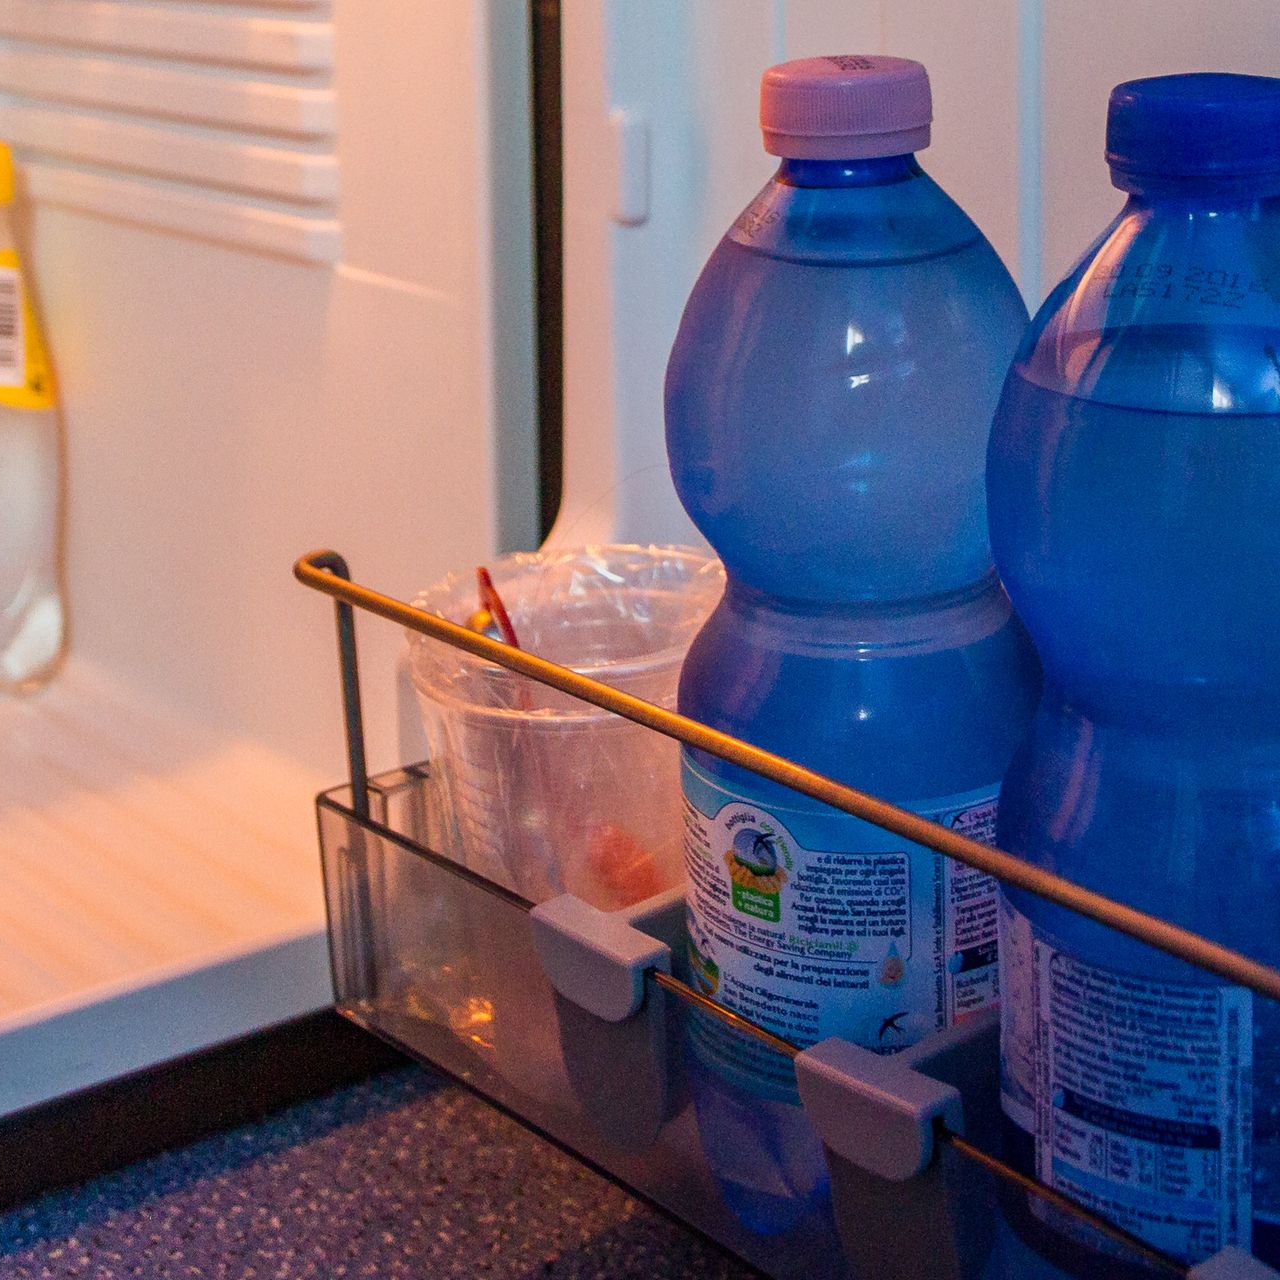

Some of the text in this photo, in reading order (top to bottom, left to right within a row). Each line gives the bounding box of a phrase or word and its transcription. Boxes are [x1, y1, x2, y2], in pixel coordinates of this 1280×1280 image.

[873, 854, 906, 869] plastica
[844, 867, 858, 877] per
[836, 886, 873, 896] emissioni
[866, 907, 907, 917] Benedetto
[828, 918, 855, 927] natura
[830, 928, 845, 937] per
[749, 930, 776, 948] Energy
[777, 941, 806, 956] Saving
[807, 945, 854, 961] Company
[773, 956, 789, 969] per
[791, 959, 800, 970] la
[801, 962, 870, 978] preparazione
[775, 970, 814, 985] alimenti
[833, 978, 870, 991] lattanti
[739, 991, 788, 1017] Benedetto
[789, 1009, 820, 1022] nasce
